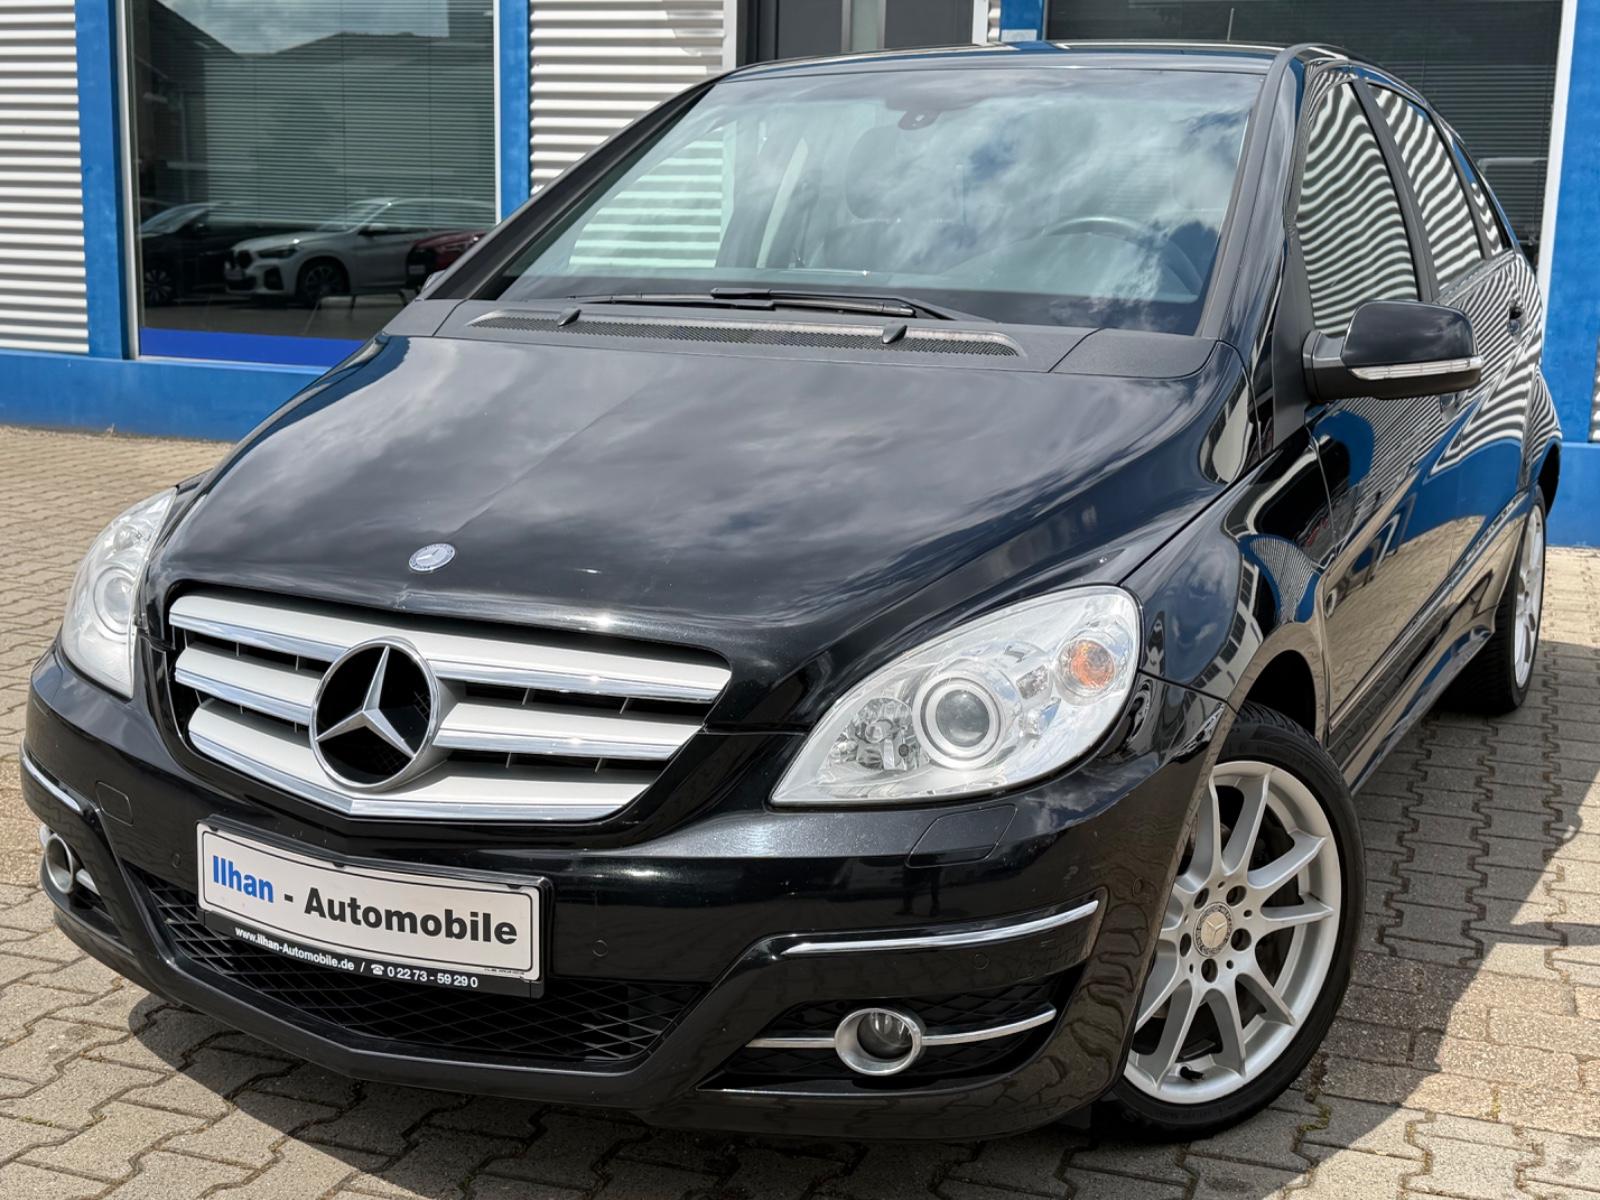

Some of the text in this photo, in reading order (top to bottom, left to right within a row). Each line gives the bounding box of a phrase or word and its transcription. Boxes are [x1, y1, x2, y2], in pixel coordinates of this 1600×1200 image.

[212, 855, 517, 945] Ilhan - Automobile
